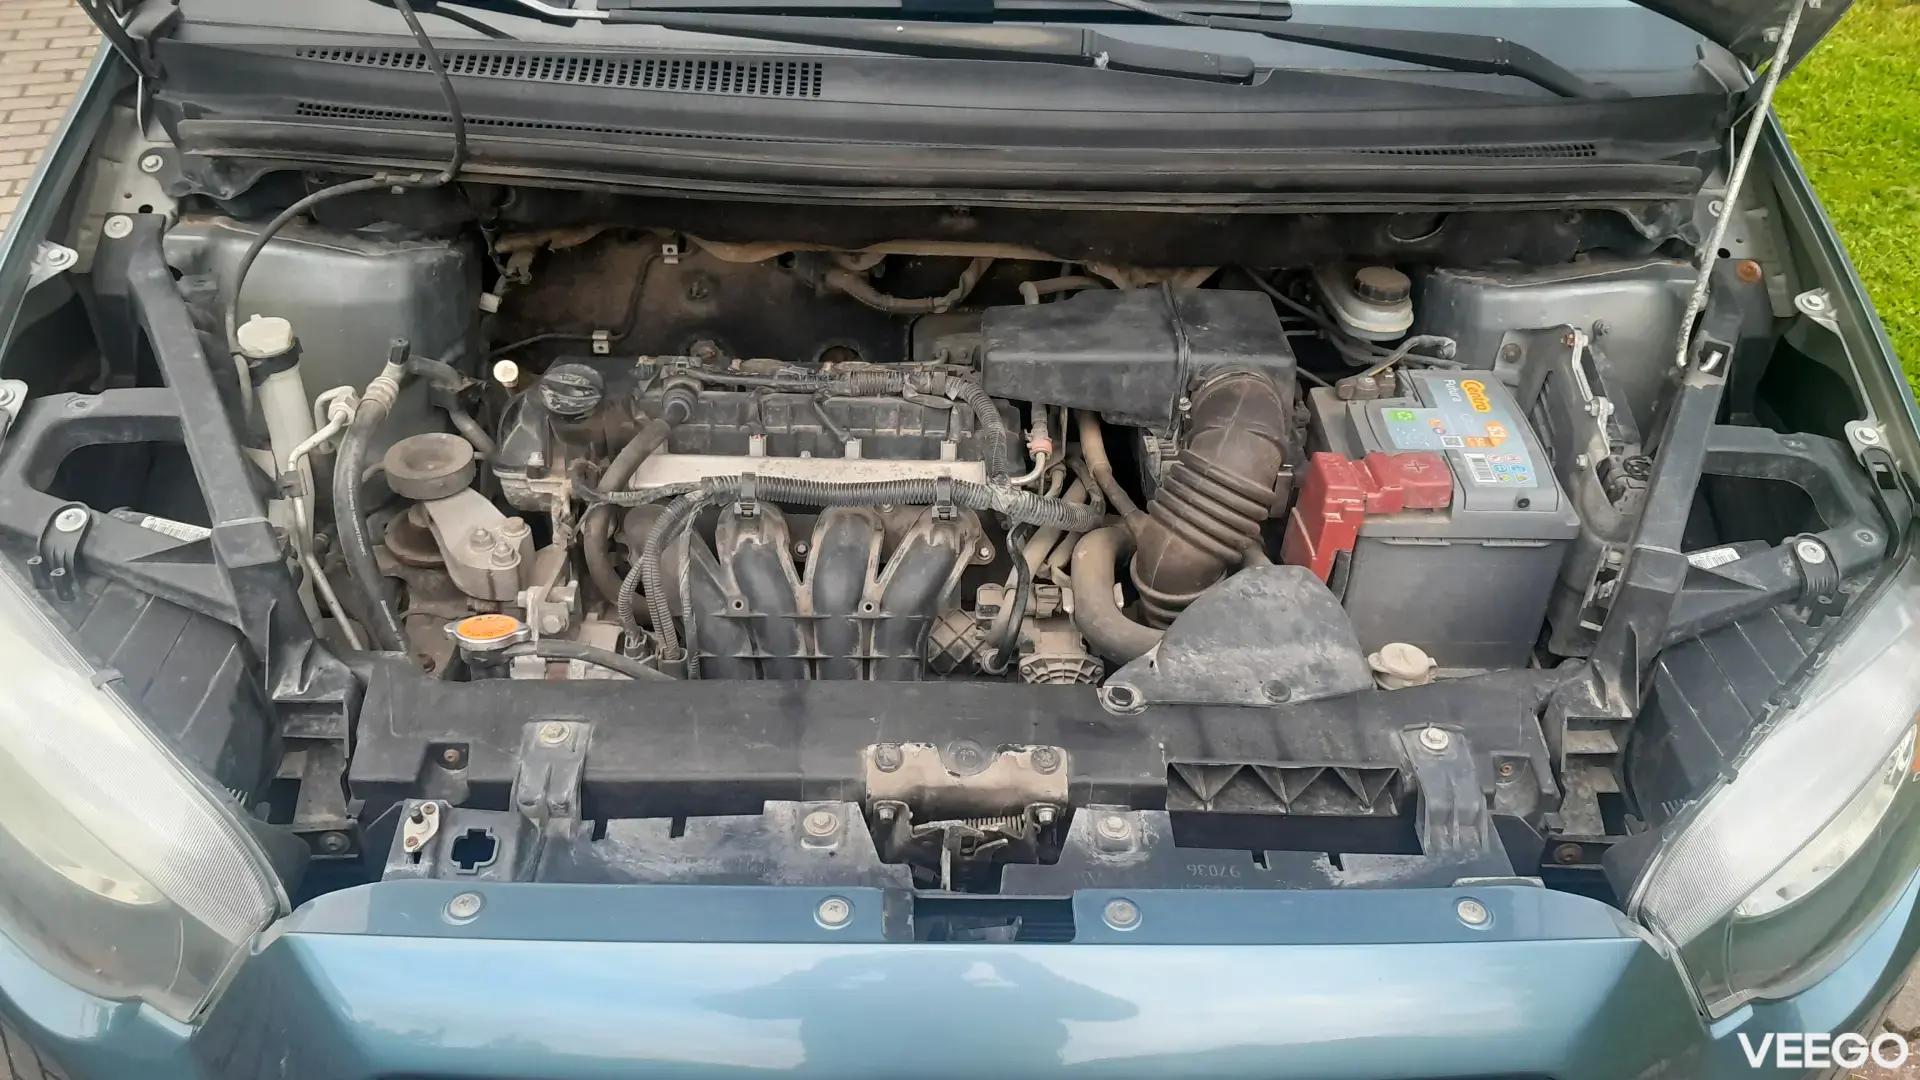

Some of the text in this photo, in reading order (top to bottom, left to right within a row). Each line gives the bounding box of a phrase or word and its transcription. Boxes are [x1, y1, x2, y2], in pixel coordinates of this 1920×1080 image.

[1444, 379, 1462, 402] Futura
[1462, 380, 1490, 412] Centra
[1186, 864, 1240, 878] 97036
